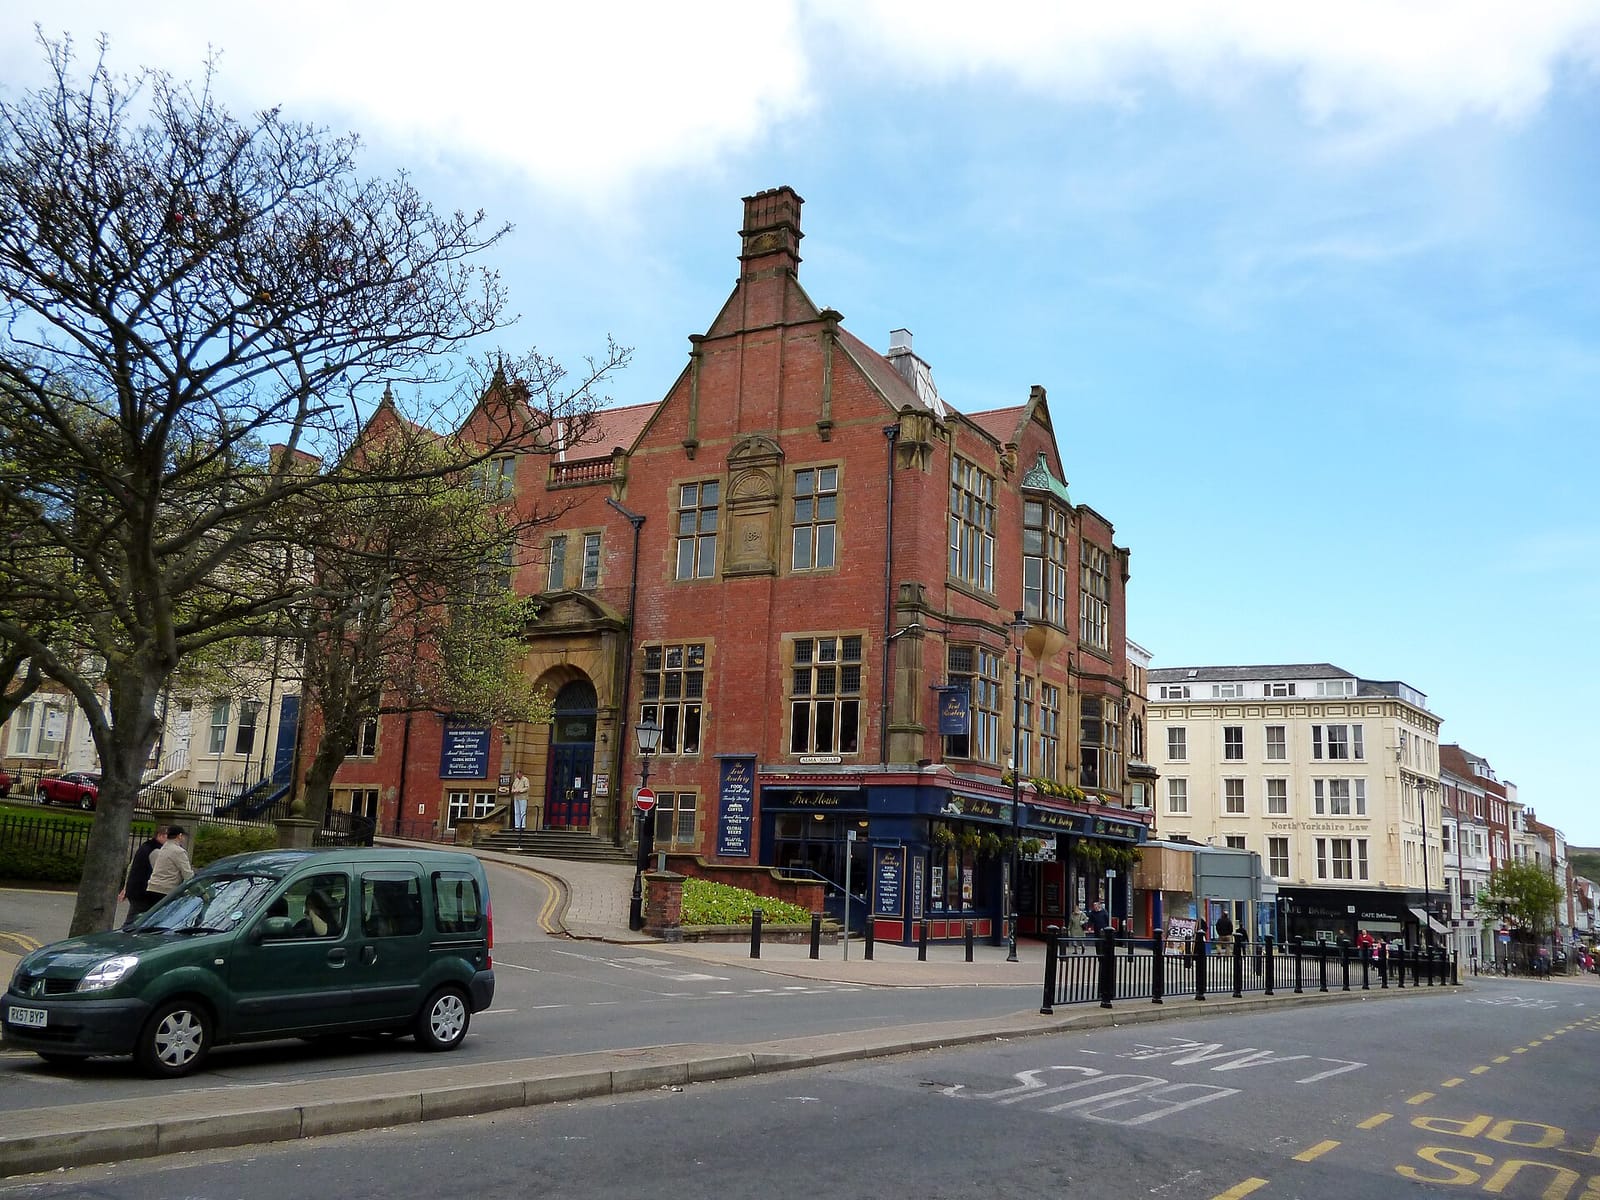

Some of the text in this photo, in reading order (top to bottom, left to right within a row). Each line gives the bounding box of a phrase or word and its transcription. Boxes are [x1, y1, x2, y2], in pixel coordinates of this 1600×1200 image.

[1271, 822, 1369, 831] North Yorkshire Law
[29, 1010, 44, 1023] BYP
[938, 1065, 1244, 1126] BUS
